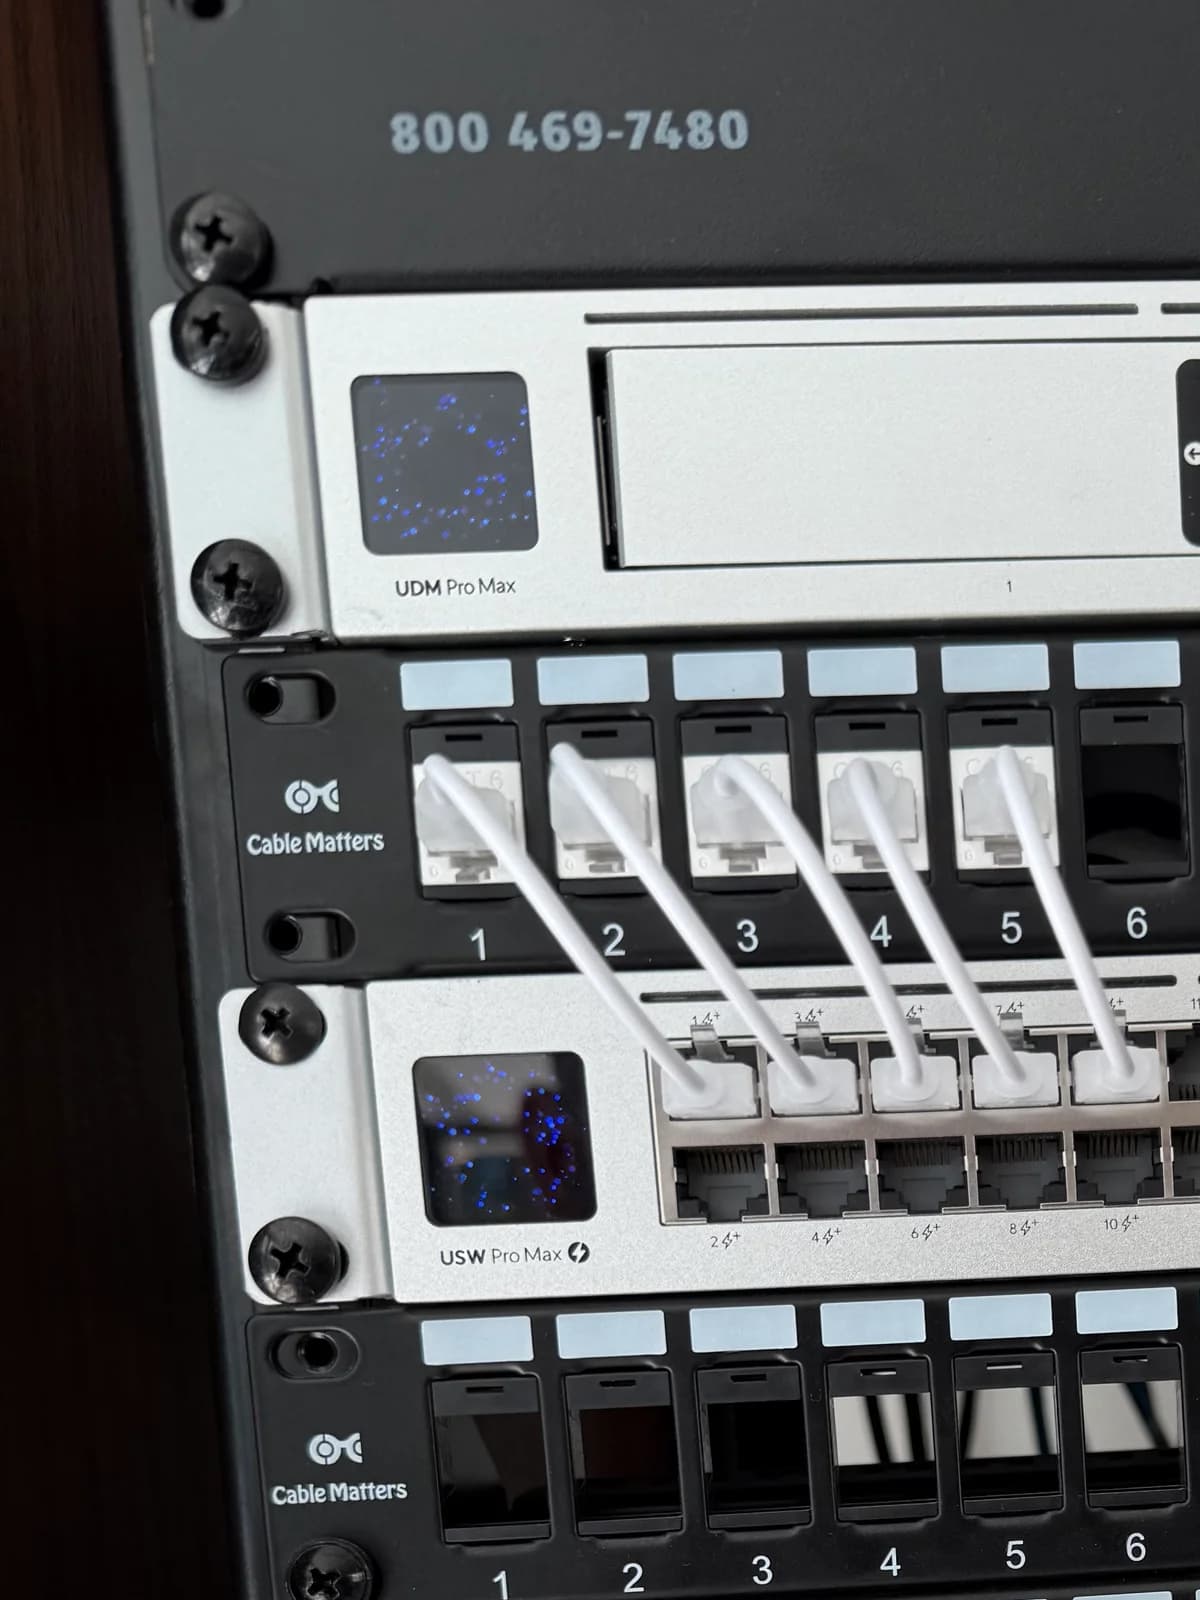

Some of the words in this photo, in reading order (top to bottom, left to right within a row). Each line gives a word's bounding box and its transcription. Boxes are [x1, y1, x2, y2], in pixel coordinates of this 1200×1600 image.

[390, 111, 489, 154] 800
[508, 109, 749, 152] 469-7480
[395, 579, 442, 597] UDM
[446, 578, 475, 596] Pro
[478, 577, 516, 595] Max
[246, 832, 303, 856] Cable
[305, 831, 385, 853] Matters
[737, 919, 759, 953] 3
[869, 915, 893, 948] 4
[1001, 911, 1023, 944] 5
[1126, 906, 1148, 939] 6
[471, 928, 486, 961] 1
[603, 923, 626, 957] 2
[440, 1249, 486, 1266] USW
[491, 1247, 521, 1265] Pro
[523, 1246, 562, 1263] Max
[271, 1483, 327, 1505] Cable
[329, 1482, 408, 1502] Matters
[879, 1547, 901, 1577] 4
[1006, 1539, 1026, 1570] 5
[1126, 1532, 1147, 1562] 6
[493, 1570, 509, 1600] 1
[622, 1562, 645, 1593] 2
[751, 1555, 773, 1585] 3
